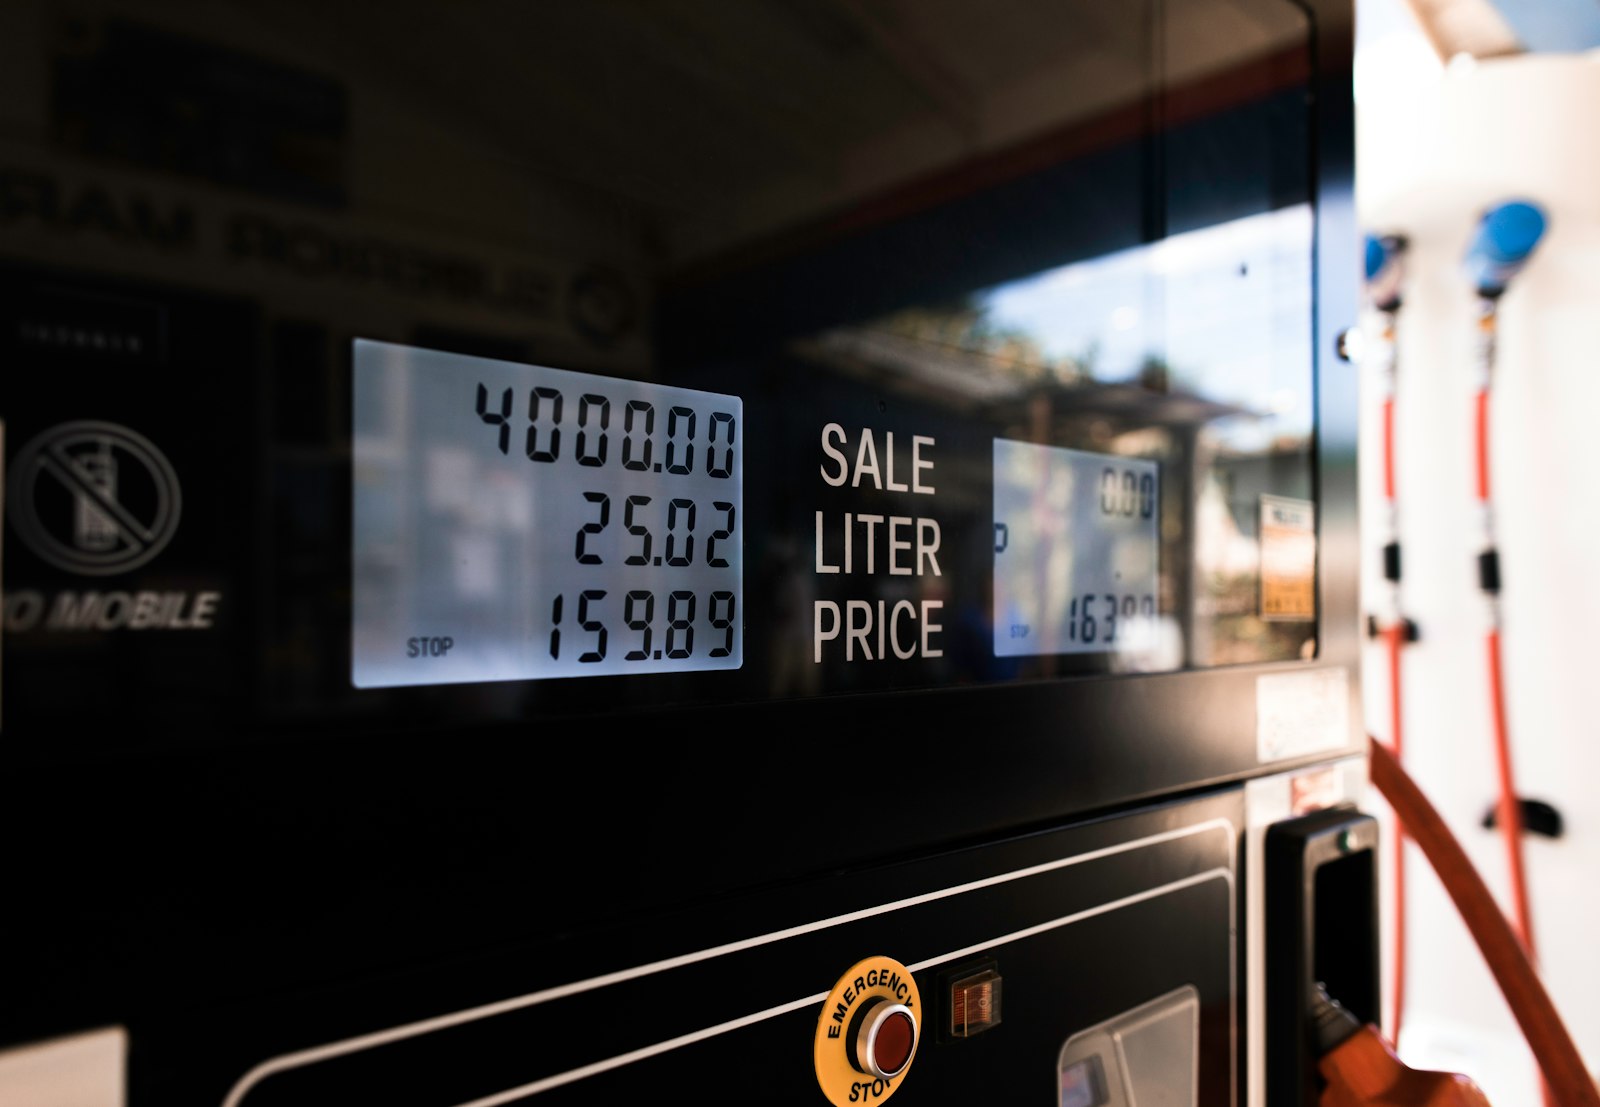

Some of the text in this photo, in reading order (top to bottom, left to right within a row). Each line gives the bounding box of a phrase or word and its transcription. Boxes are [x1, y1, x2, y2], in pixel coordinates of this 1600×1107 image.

[475, 381, 736, 479] 4000.00
[820, 422, 936, 495] SALE
[575, 491, 736, 568] 25.02
[815, 510, 942, 577] LITER
[47, 590, 222, 631] MOBILE
[549, 589, 736, 663] 159.89
[813, 599, 944, 664] PRICE
[407, 636, 454, 658] STOP
[828, 969, 913, 1038] EMERGENCY
